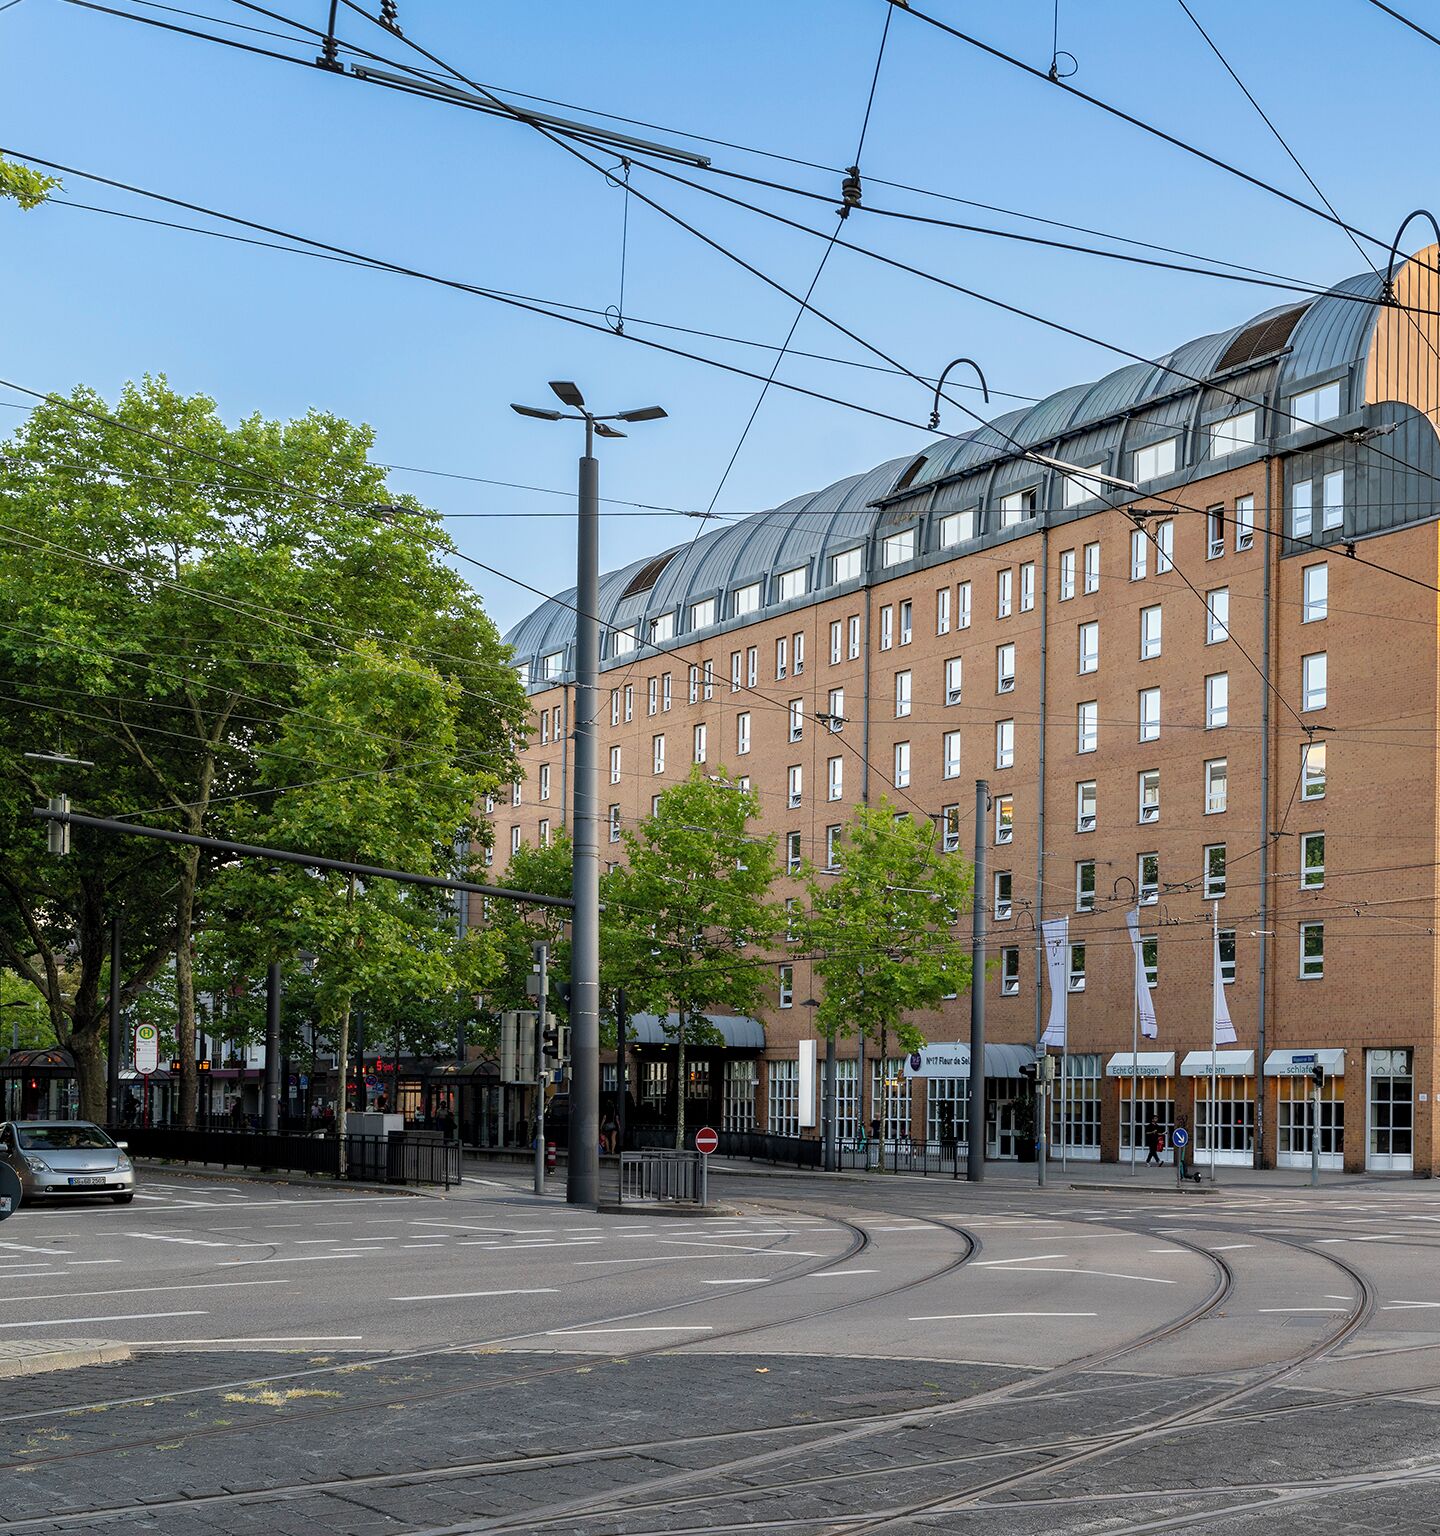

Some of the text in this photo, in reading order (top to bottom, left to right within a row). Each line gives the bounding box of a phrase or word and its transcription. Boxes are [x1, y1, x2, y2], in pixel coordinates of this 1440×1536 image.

[939, 1056, 953, 1066] Fleur
[954, 1056, 961, 1066] de
[1112, 1066, 1127, 1075] Echt
[1141, 1066, 1159, 1077] tagen
